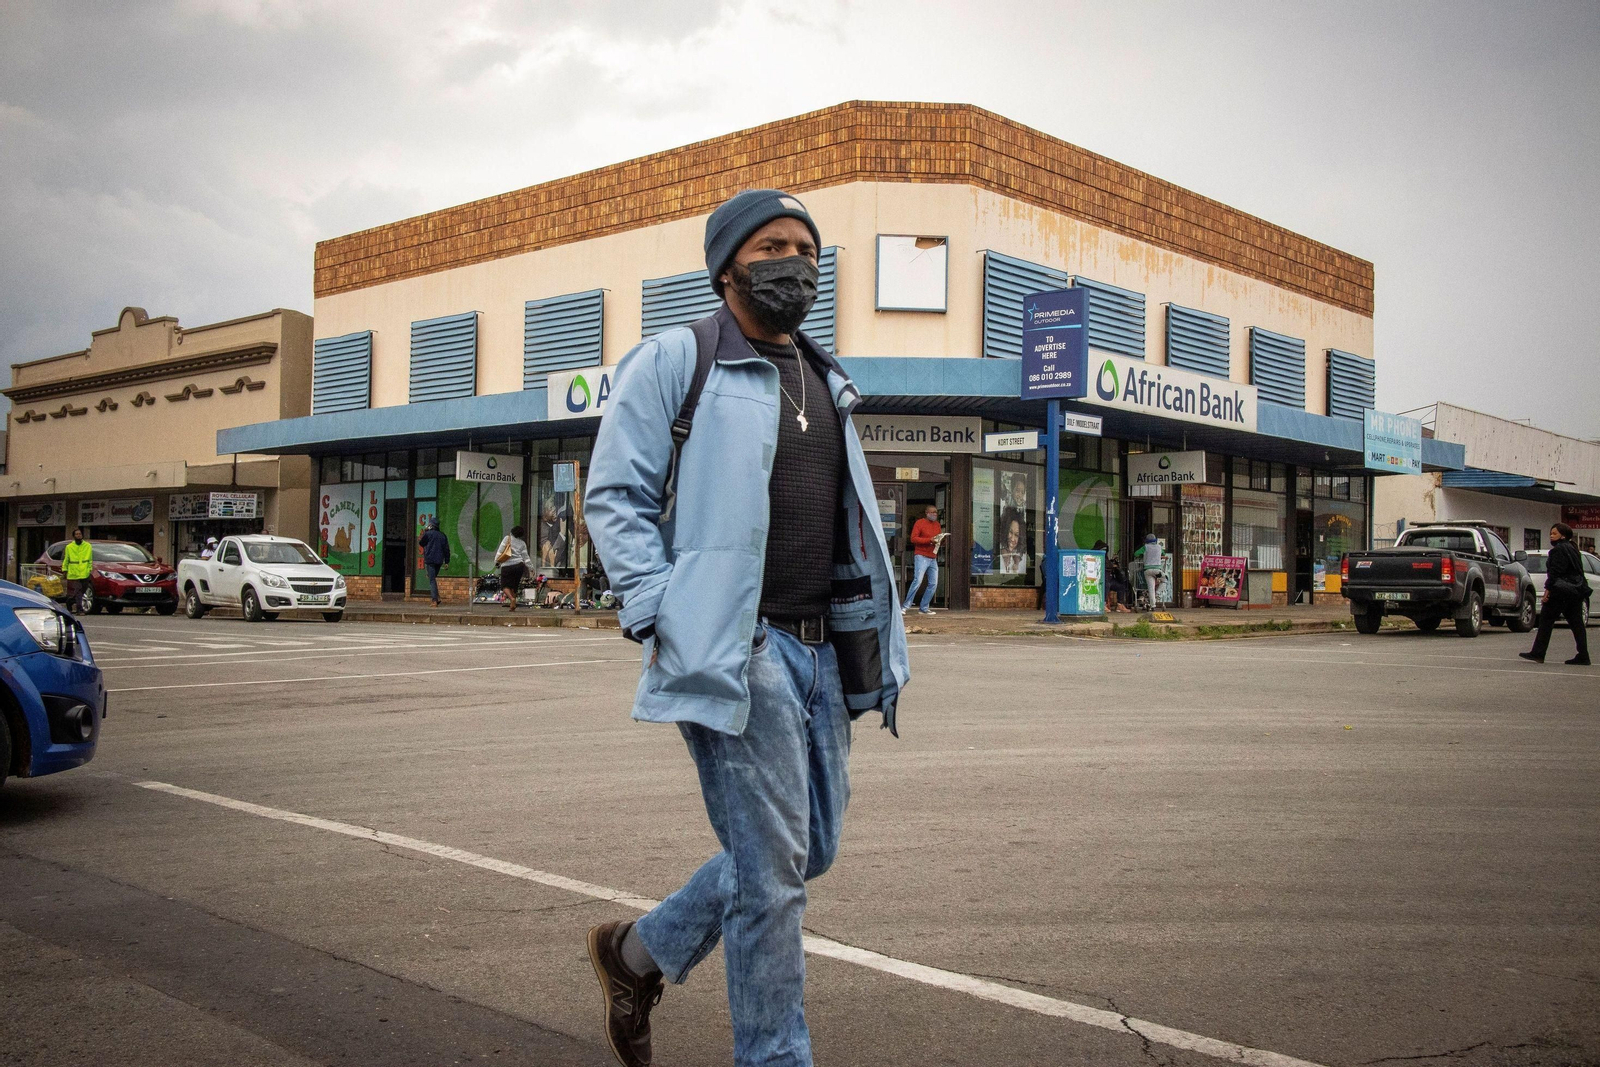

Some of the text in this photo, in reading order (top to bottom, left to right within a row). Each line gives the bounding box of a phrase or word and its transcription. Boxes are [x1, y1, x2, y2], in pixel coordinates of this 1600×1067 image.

[1034, 308, 1075, 319] PRIMEDIA
[1034, 317, 1061, 325] OUTDOOR
[1045, 335, 1054, 343] TO
[1034, 342, 1066, 353] ADVERTISE
[1041, 351, 1058, 360] HERE
[1043, 364, 1055, 372] Call
[1028, 371, 1072, 382] 086 010 2989
[1122, 366, 1245, 424] African Bank
[1370, 413, 1417, 438] MR PHONE
[861, 424, 976, 443] African Bank
[997, 436, 1025, 447] KORT STREET
[466, 469, 517, 483] African Bank
[1136, 471, 1195, 483] African Bank
[329, 500, 360, 519] CAMELA
[367, 489, 378, 568] LOANS
